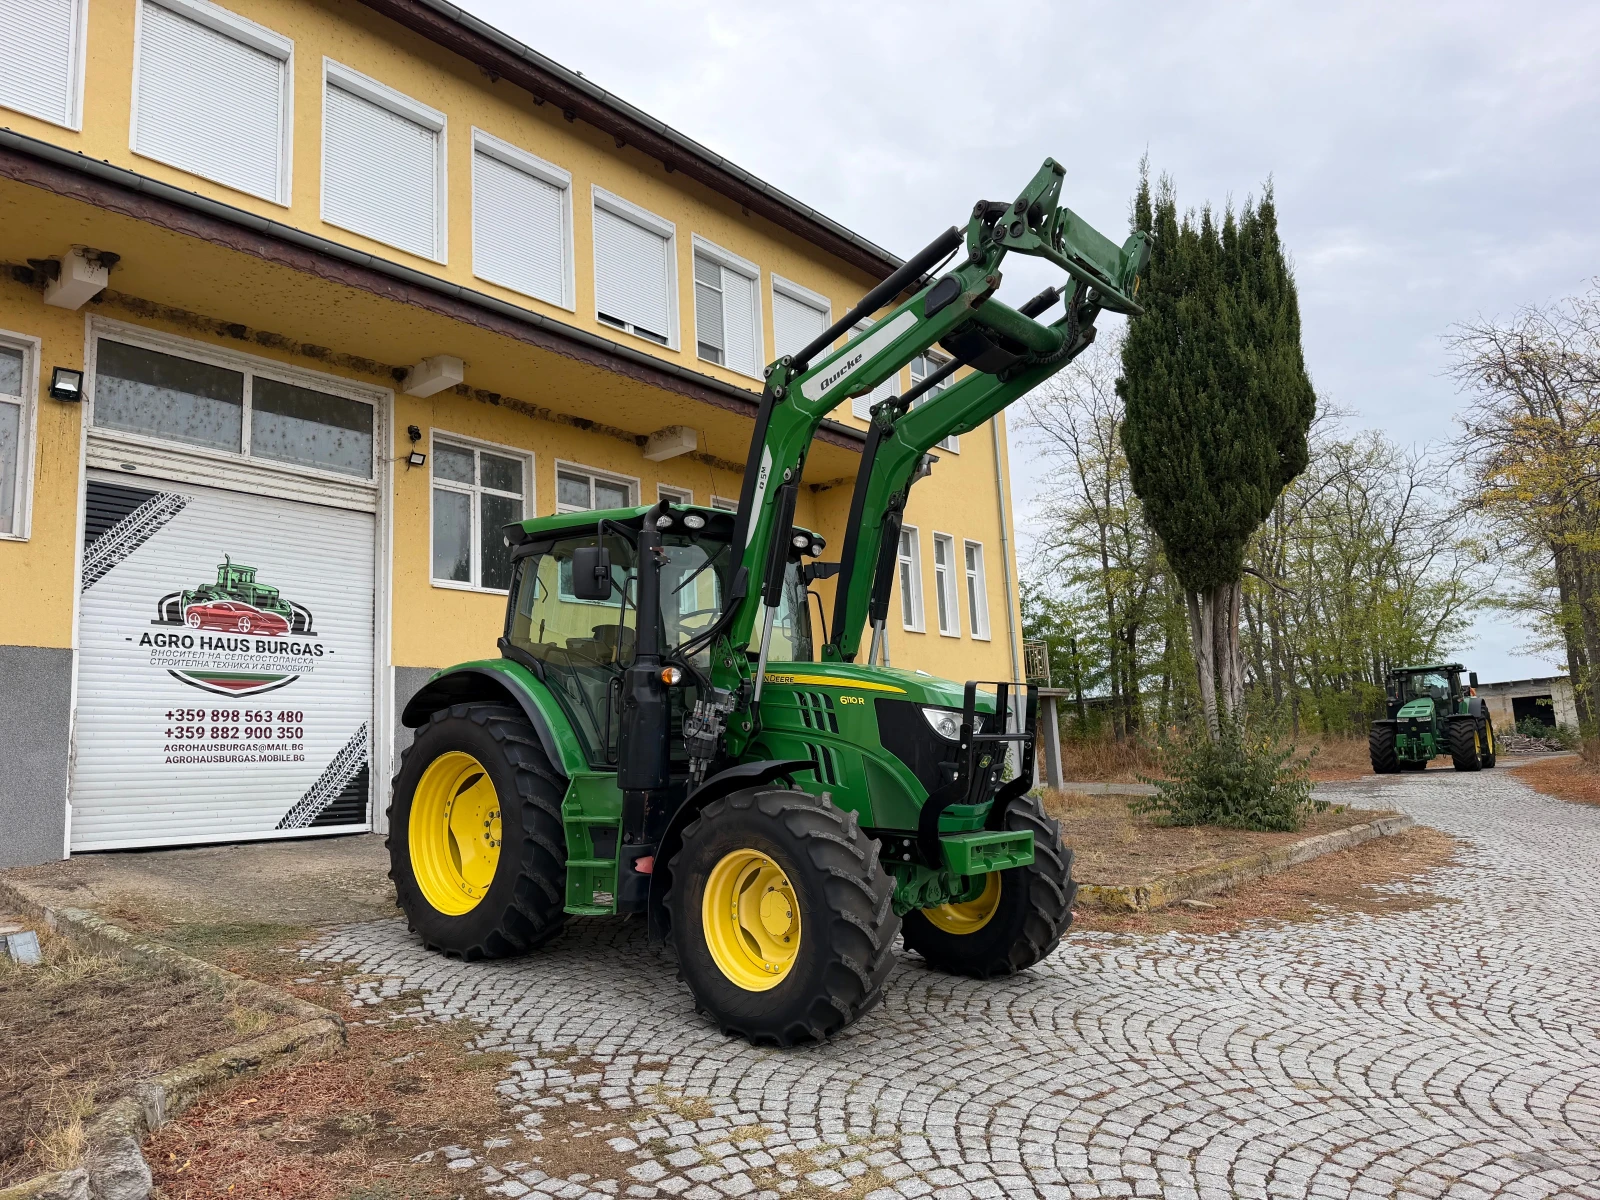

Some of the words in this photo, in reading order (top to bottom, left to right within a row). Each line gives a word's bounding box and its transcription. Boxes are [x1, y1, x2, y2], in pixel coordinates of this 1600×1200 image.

[820, 353, 863, 391] Quicke
[139, 632, 195, 649] AGRO
[200, 636, 250, 653] HAUS
[255, 640, 324, 657] BURGAS
[150, 648, 205, 659] ВНОСИТЕЛ
[207, 652, 221, 660] НА
[224, 652, 314, 665] СЕЛСКОСТОПАНСКА
[149, 657, 210, 668] СТРОИТЕЛНА
[212, 661, 250, 670] ТЕХНИКА
[259, 663, 314, 673] АВТОМОБИЛИ
[770, 674, 795, 683] DEERE
[165, 708, 206, 722] +359
[210, 709, 240, 723] 898
[244, 710, 273, 723] 563
[276, 710, 304, 723] 480
[164, 726, 205, 740] +359
[210, 726, 240, 739] 882
[244, 726, 273, 739] 900
[276, 726, 304, 739] 350
[163, 743, 304, 753] AGROHAUSBURGAS@MAIL.BG
[165, 754, 305, 764] AGROHAUSBURGAS.MOBILE.BG
